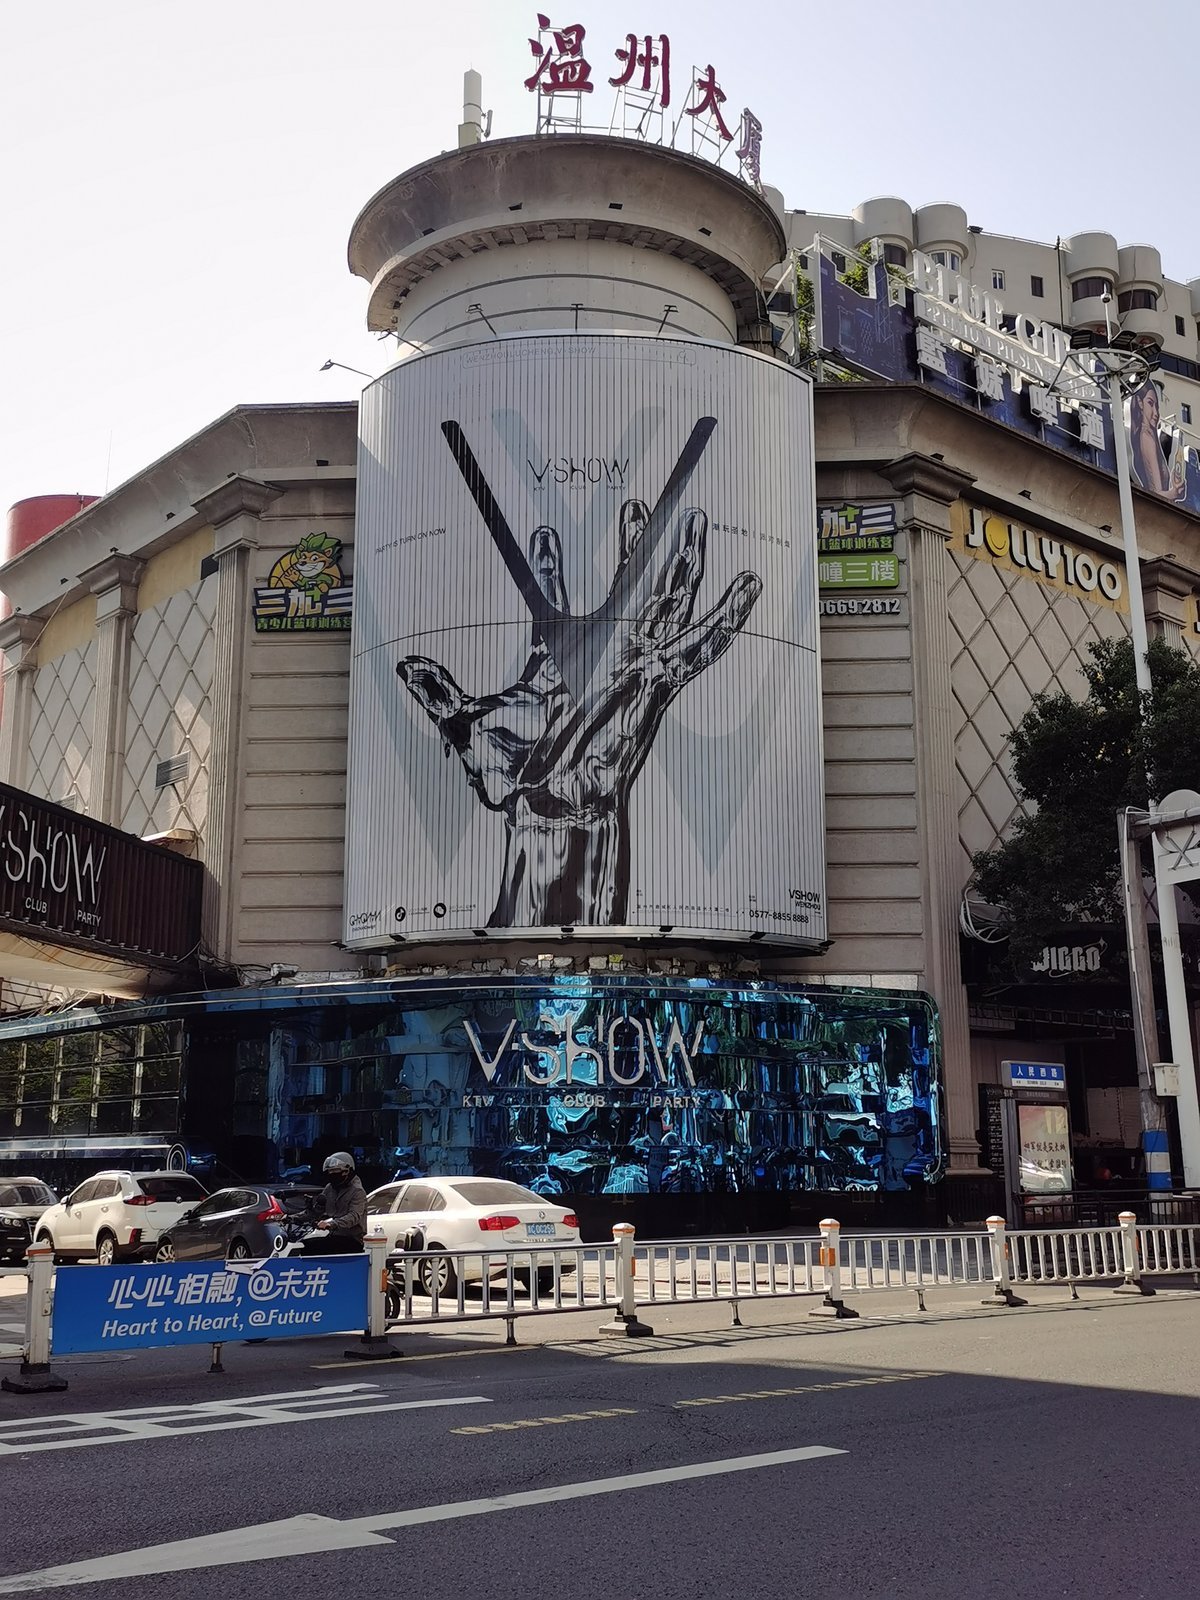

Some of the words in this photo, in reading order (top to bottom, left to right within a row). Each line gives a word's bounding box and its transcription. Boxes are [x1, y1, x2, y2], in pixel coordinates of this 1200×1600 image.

[912, 249, 1004, 332] BLUE
[429, 527, 446, 537] NOW
[817, 505, 895, 538] 加三
[819, 560, 895, 582] 幢三楼
[789, 888, 820, 903] VSHOW
[25, 897, 47, 914] CLUB
[77, 910, 101, 928] PARTY
[462, 1095, 494, 1107] KTV
[563, 1094, 606, 1107] CLUB
[652, 1095, 702, 1108] PARTY
[101, 1317, 158, 1338] Heart
[163, 1317, 183, 1333] to
[187, 1313, 244, 1332] Heart,
[248, 1308, 323, 1328] @Future
